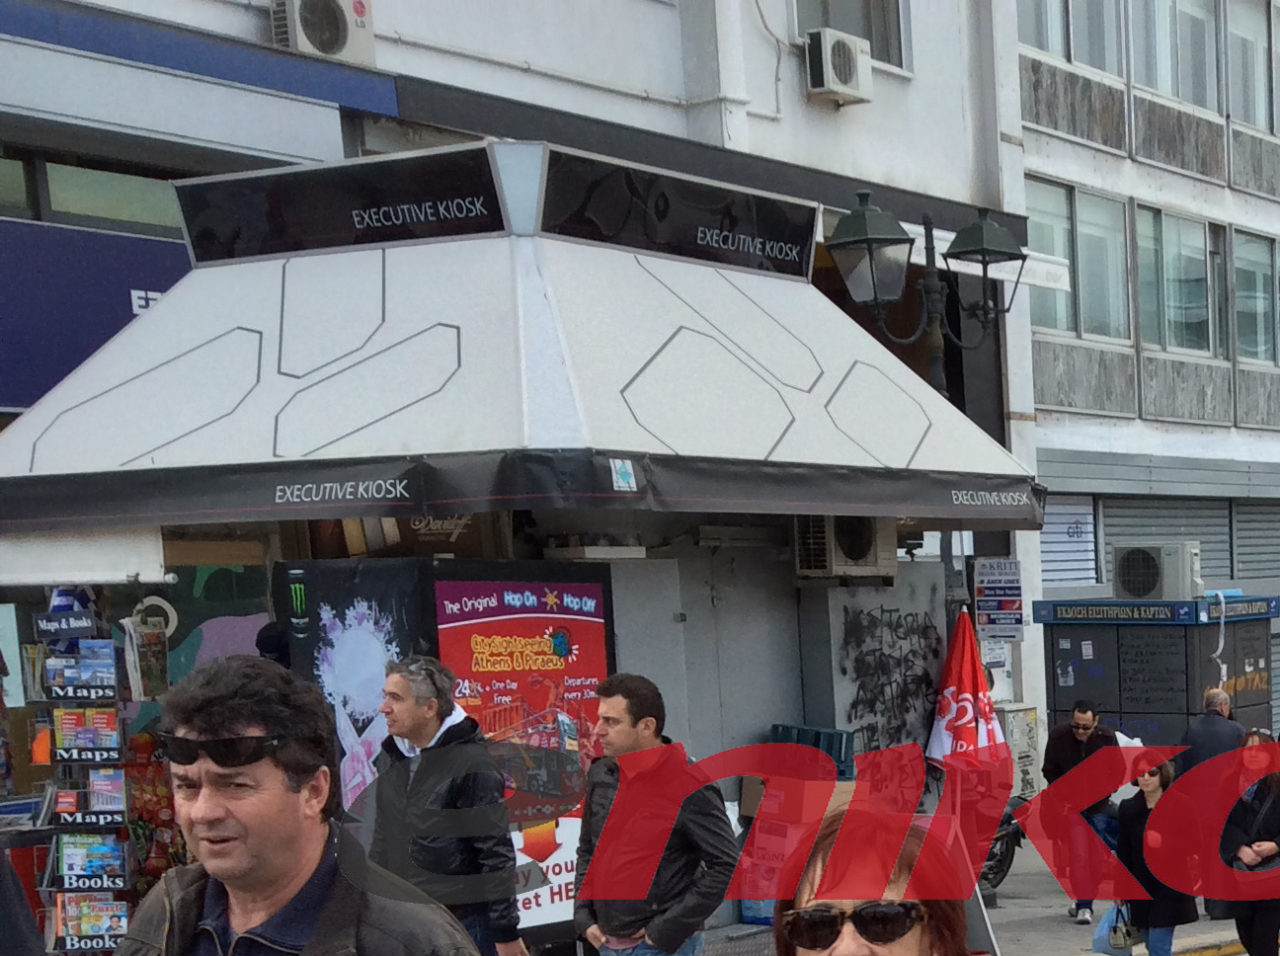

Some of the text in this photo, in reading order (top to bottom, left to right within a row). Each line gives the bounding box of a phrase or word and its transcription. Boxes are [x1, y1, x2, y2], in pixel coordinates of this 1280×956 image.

[352, 196, 488, 229] EXECUTIVE KIOSK
[696, 226, 801, 263] EXECUTIVE KIOSK
[275, 479, 411, 503] EXECUTIVE KIOSK
[951, 490, 1031, 506] EXECUTIVE KIOSK
[443, 600, 461, 615] The
[462, 593, 498, 612] Original
[503, 590, 523, 608] Hop
[523, 591, 538, 607] On
[563, 592, 581, 611] Hop
[37, 617, 92, 632] Maps & Books
[471, 634, 554, 653] CitySightseeing
[472, 653, 513, 672] Athens
[523, 652, 565, 671] Piraeus
[52, 686, 115, 700] Maps
[56, 748, 120, 762] Maps
[60, 812, 123, 826] Maps
[541, 860, 575, 883] you
[63, 874, 124, 889] Books
[549, 881, 575, 905] HE
